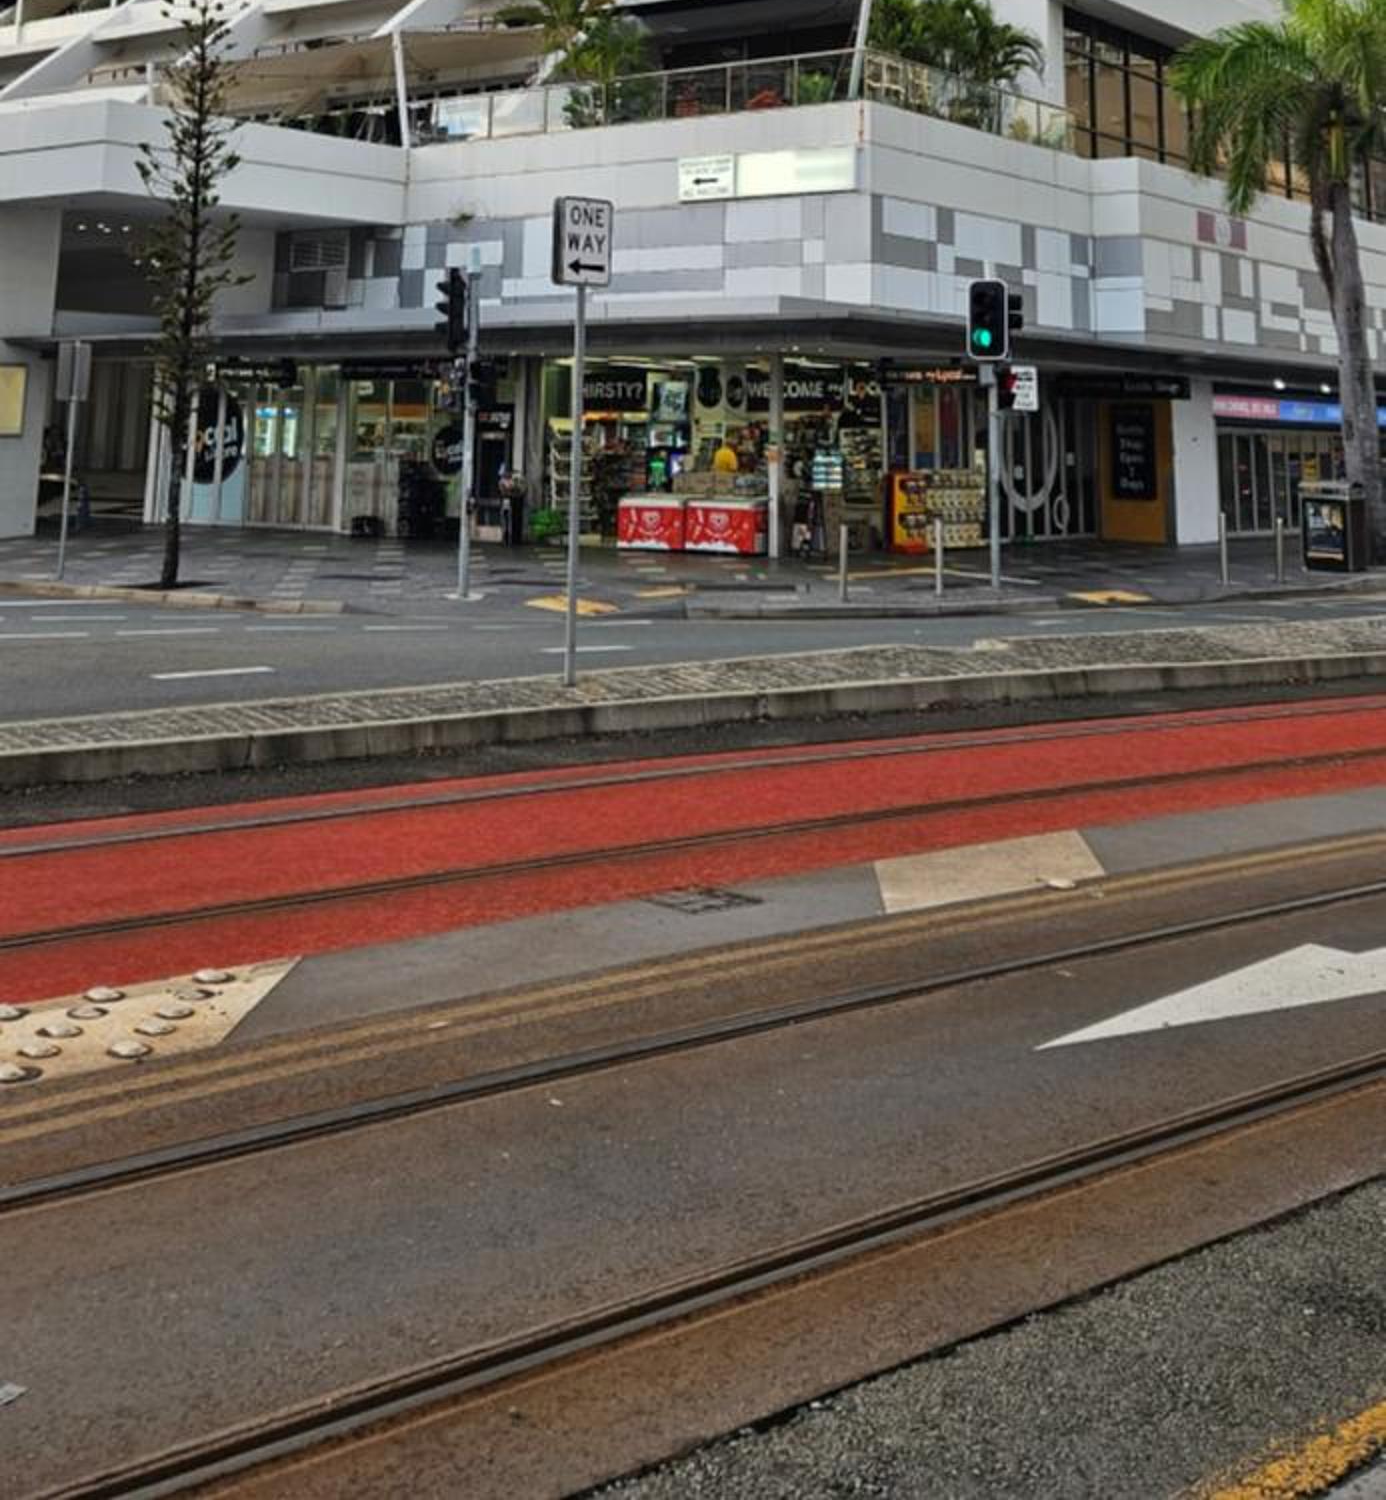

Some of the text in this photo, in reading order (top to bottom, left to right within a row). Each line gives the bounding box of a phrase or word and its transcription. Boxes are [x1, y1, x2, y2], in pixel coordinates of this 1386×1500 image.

[570, 205, 604, 228] ONE
[568, 232, 606, 254] WAY
[582, 380, 643, 399] HIRSTY?
[748, 380, 824, 398] WECOME
